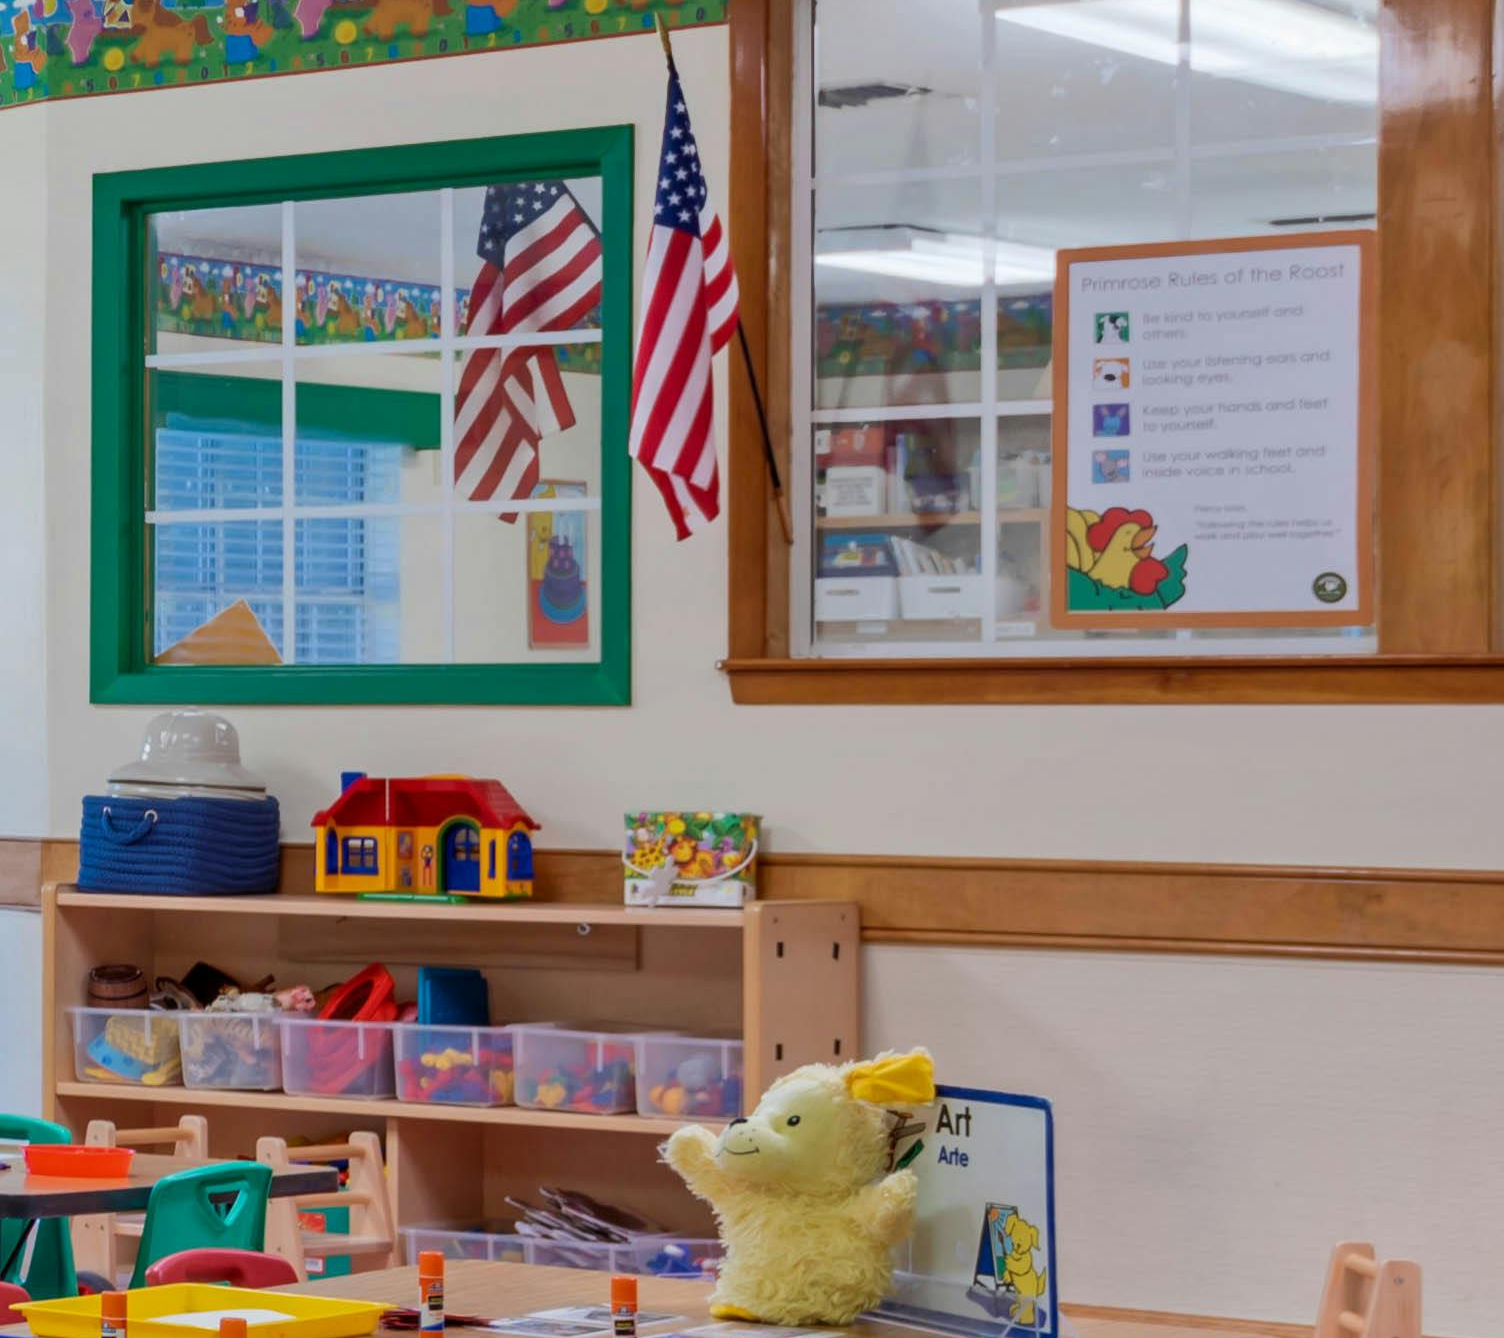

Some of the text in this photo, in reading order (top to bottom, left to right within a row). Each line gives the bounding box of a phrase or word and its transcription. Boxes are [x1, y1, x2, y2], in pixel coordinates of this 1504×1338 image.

[1081, 264, 1344, 292] Primrose Rules of the Roost
[936, 1104, 972, 1137] Art
[937, 1146, 969, 1167] Arte
